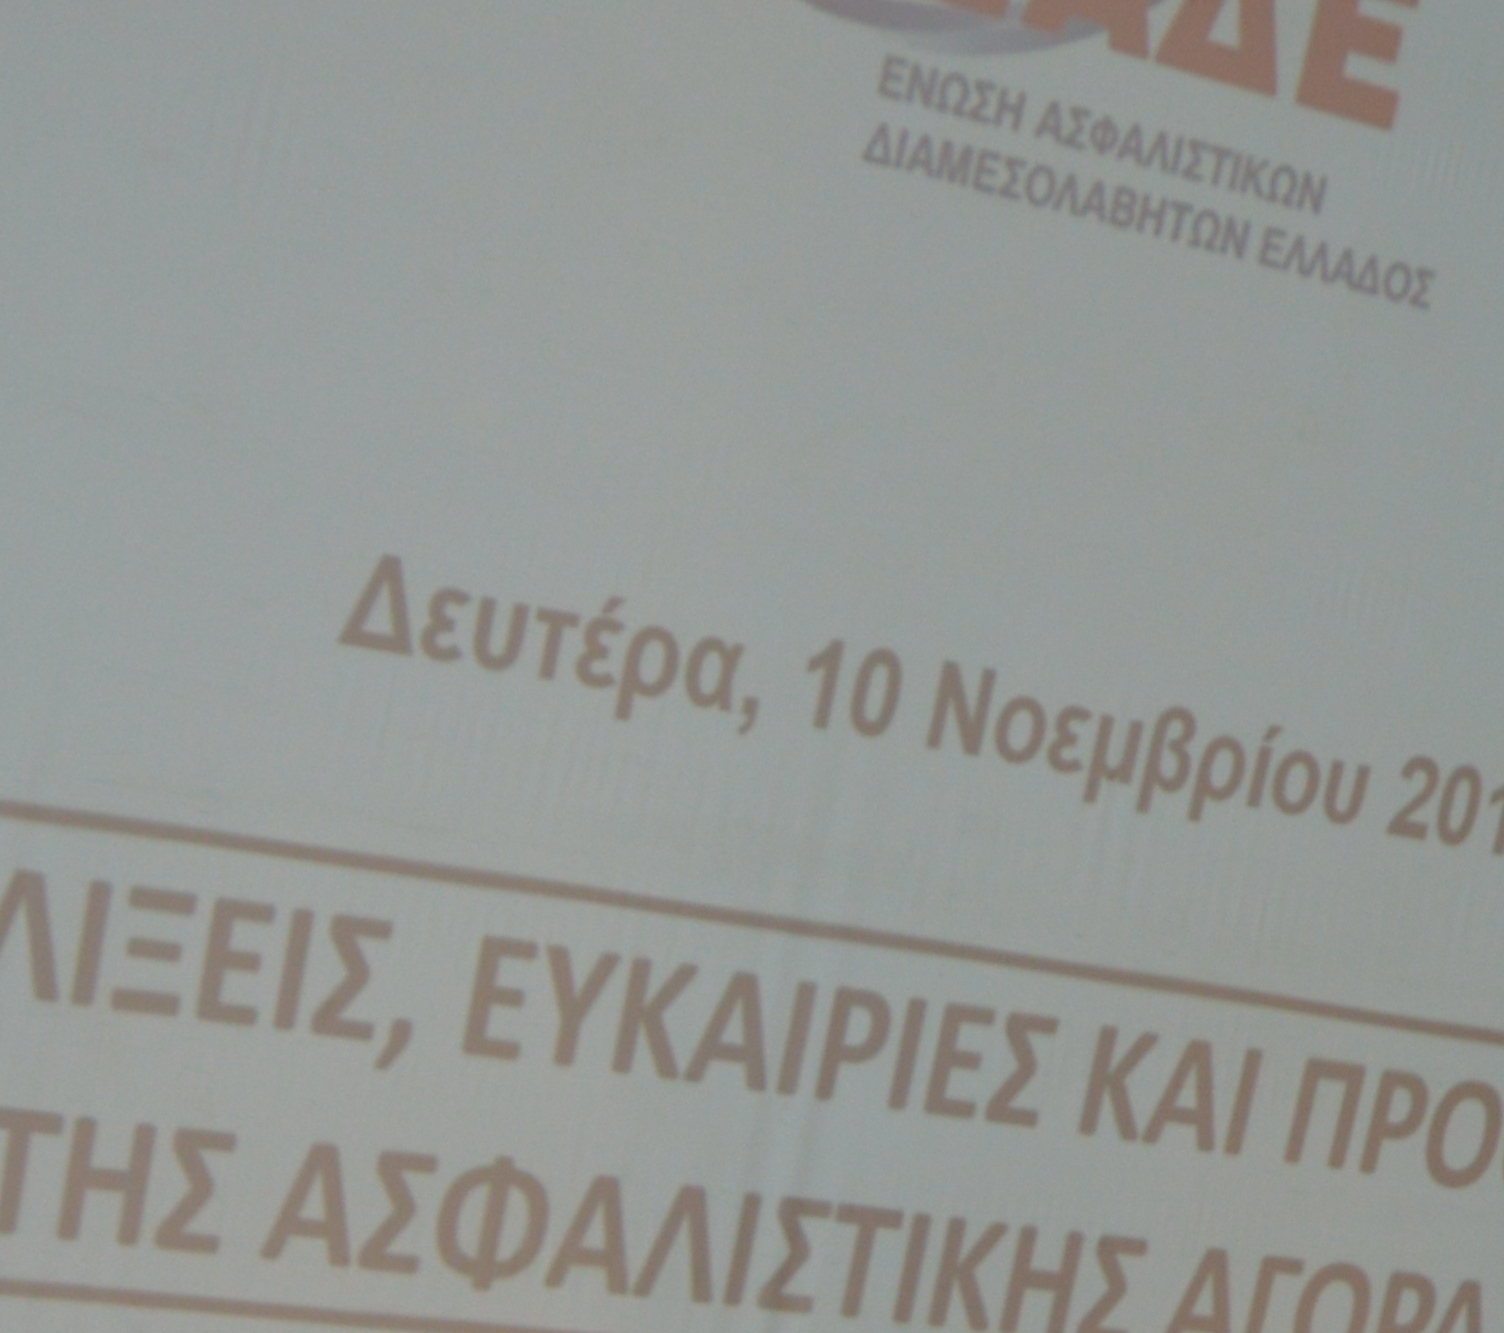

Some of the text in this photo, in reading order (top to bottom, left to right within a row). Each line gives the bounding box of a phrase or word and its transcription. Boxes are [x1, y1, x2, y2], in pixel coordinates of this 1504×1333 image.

[862, 121, 1436, 311] ΔΙΑΜΕΣΟΛΑΒΗΤΩΝ ΕΛΛΑΔΟΣ
[877, 53, 1329, 217] ΕΝΩΣΗ ΑΣΦΑΛΙΣΤΙΚΩΝ
[337, 553, 760, 736] Δευτέρα,
[805, 638, 904, 739] 10
[924, 660, 1372, 823] Νοεμβρίου
[460, 935, 1059, 1128] ΕΥΚΑΙΡΙΕΣ
[1077, 1025, 1264, 1156] ΚΑΙ
